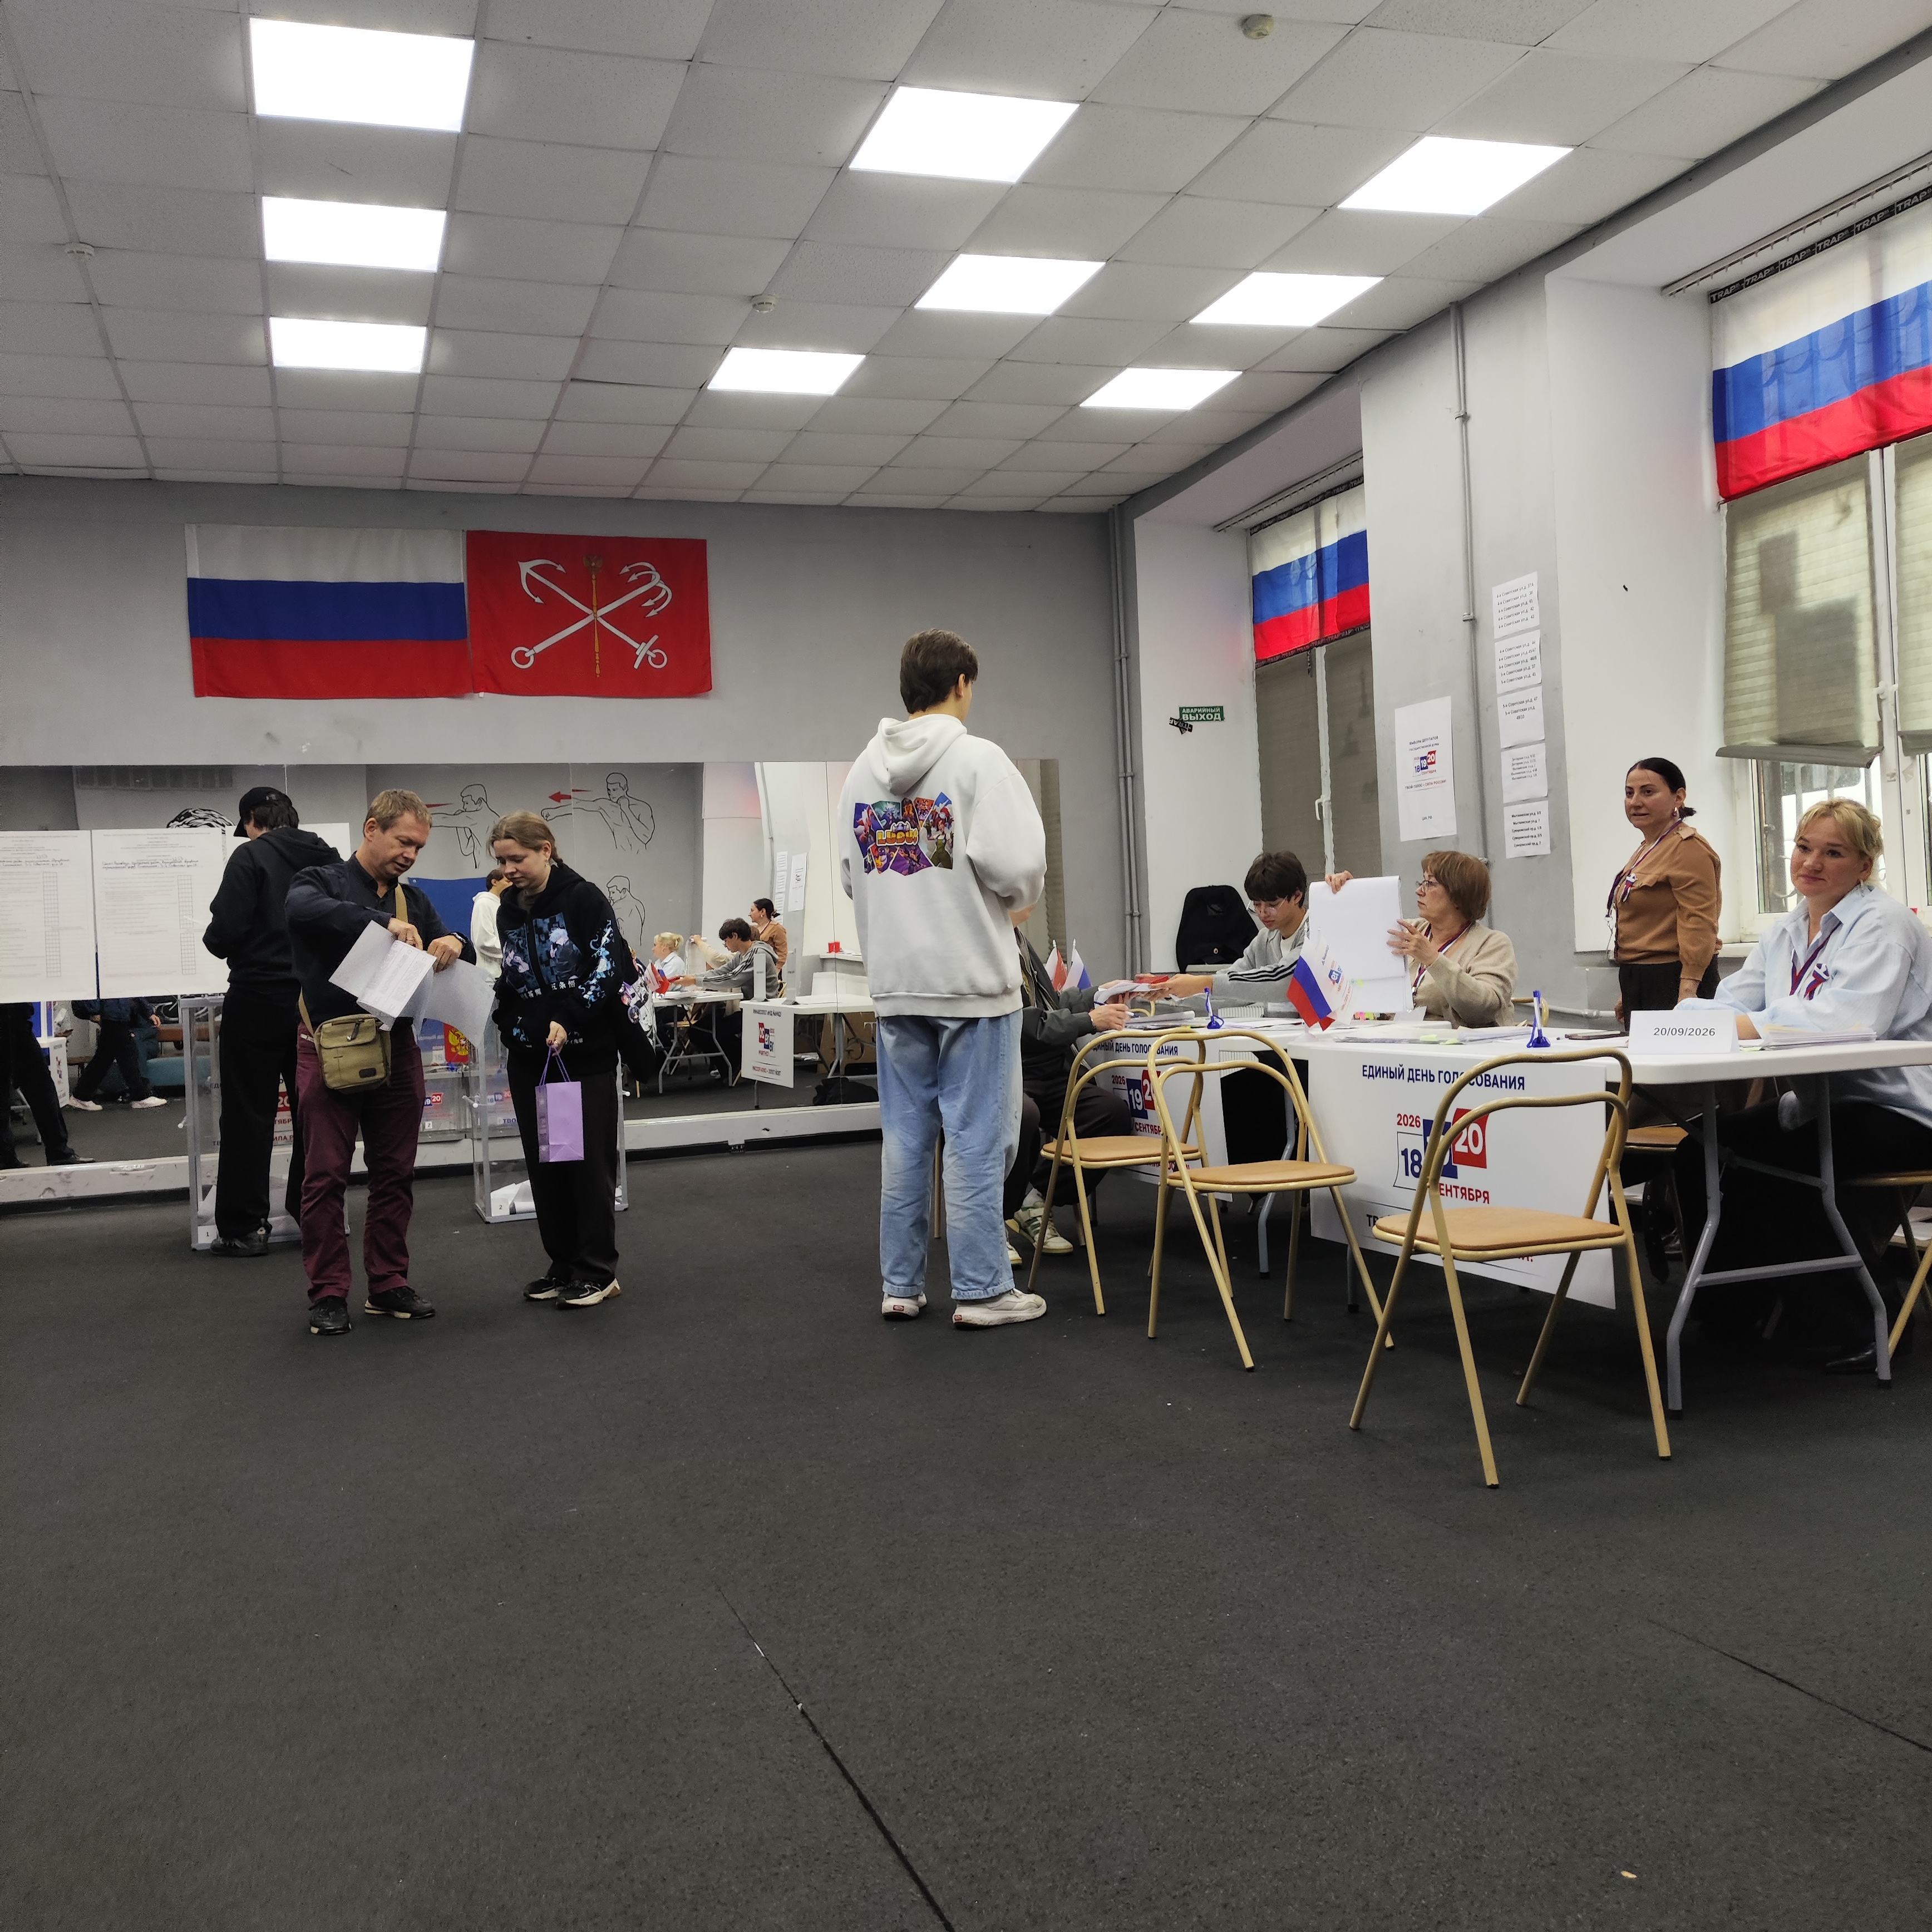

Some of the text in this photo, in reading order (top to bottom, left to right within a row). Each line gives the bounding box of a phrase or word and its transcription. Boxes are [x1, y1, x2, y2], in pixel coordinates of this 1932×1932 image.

[1182, 713, 1221, 721] ВЫХОД
[1421, 758, 1427, 768] 19
[1427, 753, 1435, 763] 20
[1653, 1027, 1716, 1036] 20/09/2026
[1093, 1039, 1114, 1052] ДИНЫЙ
[1115, 1042, 1131, 1053] ДЕНЬ
[1112, 1075, 1126, 1085] 2026
[1362, 1063, 1525, 1091] ЕДИНЫЙ ДЕНЬ ГОЛОВАНИЯ
[1129, 1088, 1143, 1111] 19
[1397, 1113, 1421, 1128] 2026
[1135, 1122, 1161, 1135] СЕНТЯБР
[1401, 1148, 1422, 1179] 18
[1455, 1122, 1483, 1155] 20
[1439, 1183, 1490, 1205] ЕНТЯБРЯ
